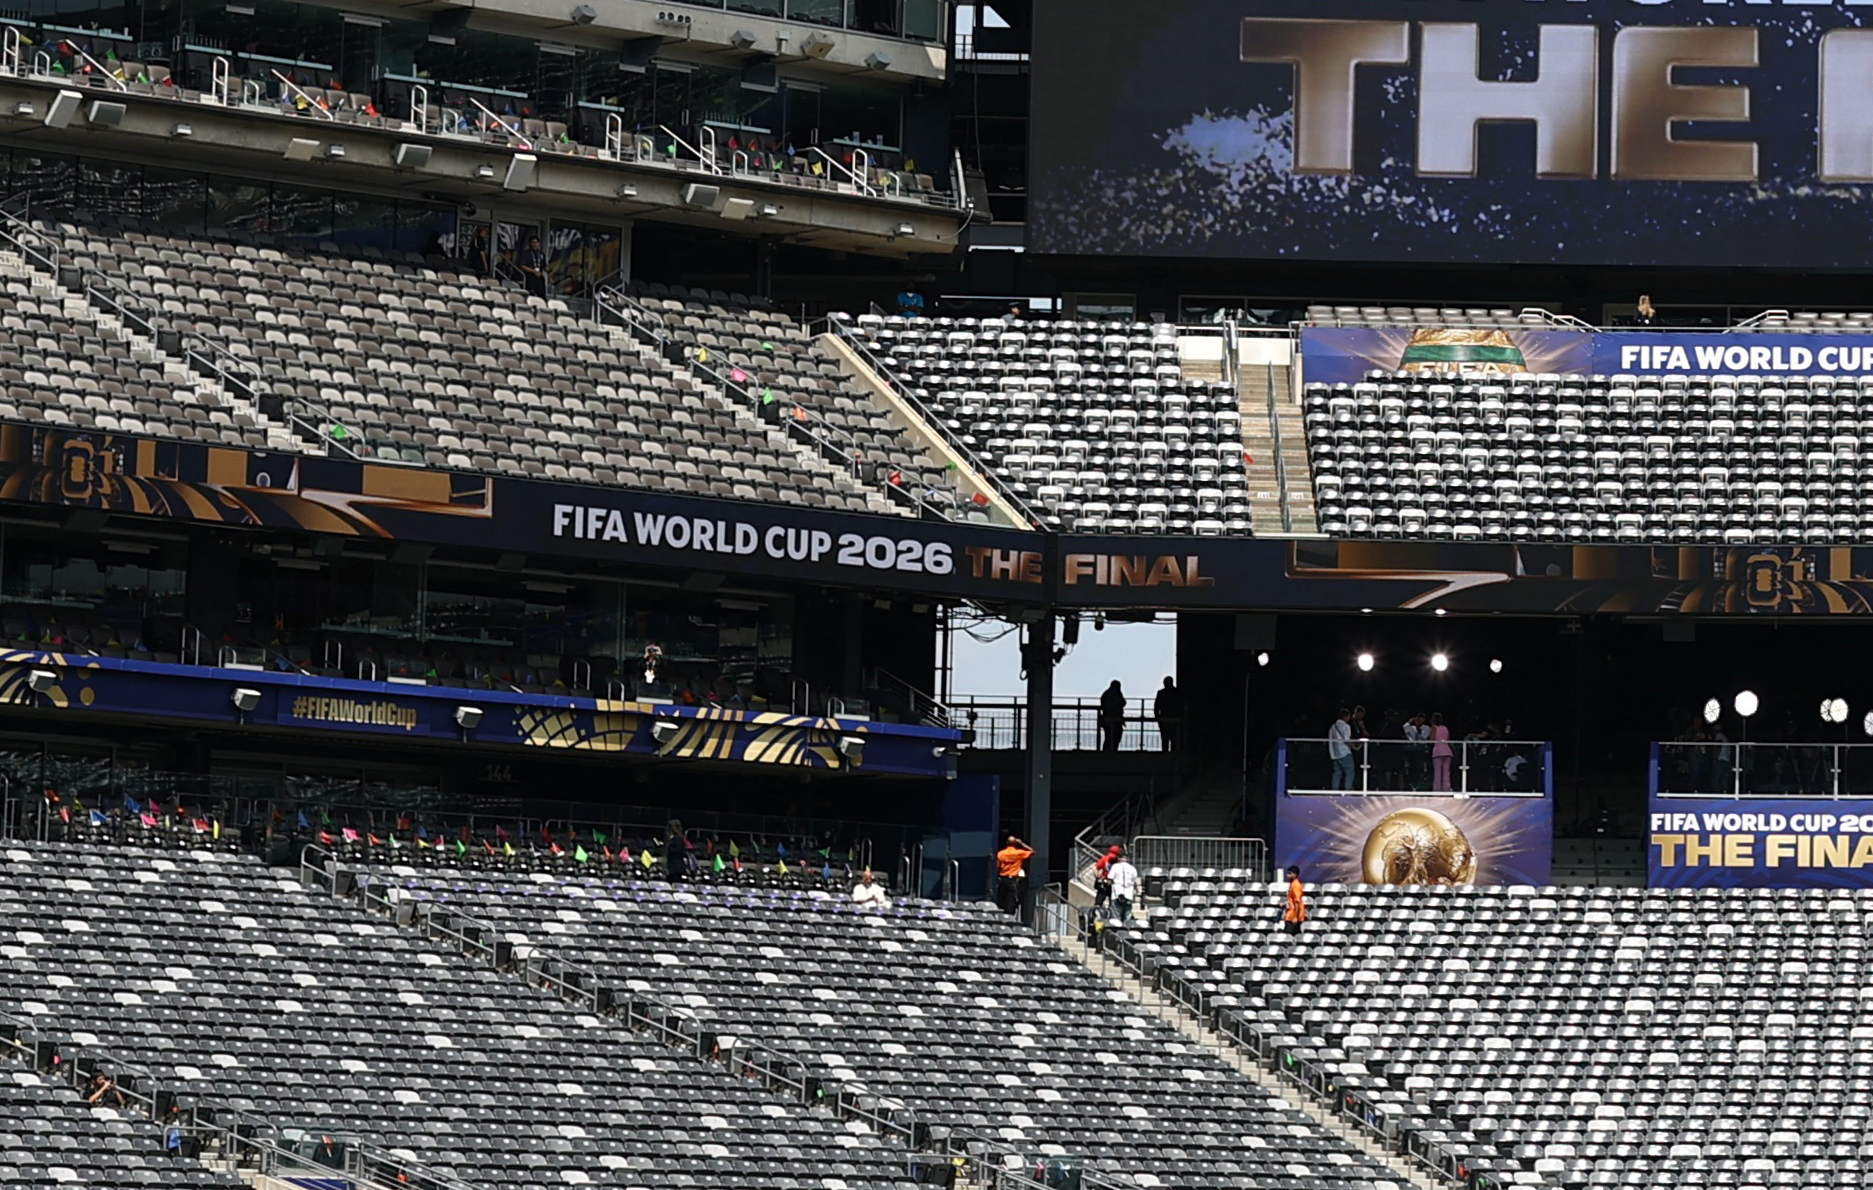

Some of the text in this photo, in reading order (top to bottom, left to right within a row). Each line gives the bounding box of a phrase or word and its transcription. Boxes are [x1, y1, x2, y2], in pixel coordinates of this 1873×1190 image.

[1240, 17, 1759, 181] THE
[1622, 346, 1691, 370] FIFA
[1694, 346, 1813, 371] WORLD
[555, 505, 1215, 586] FIFA WORLD CUP 2026 THE FINAL
[293, 697, 417, 731] #FIFAWorldCup
[1651, 813, 1700, 831] FIFA
[1702, 813, 1787, 832] WORLD
[1790, 814, 1837, 832] CUP
[1651, 834, 1755, 867] THE
